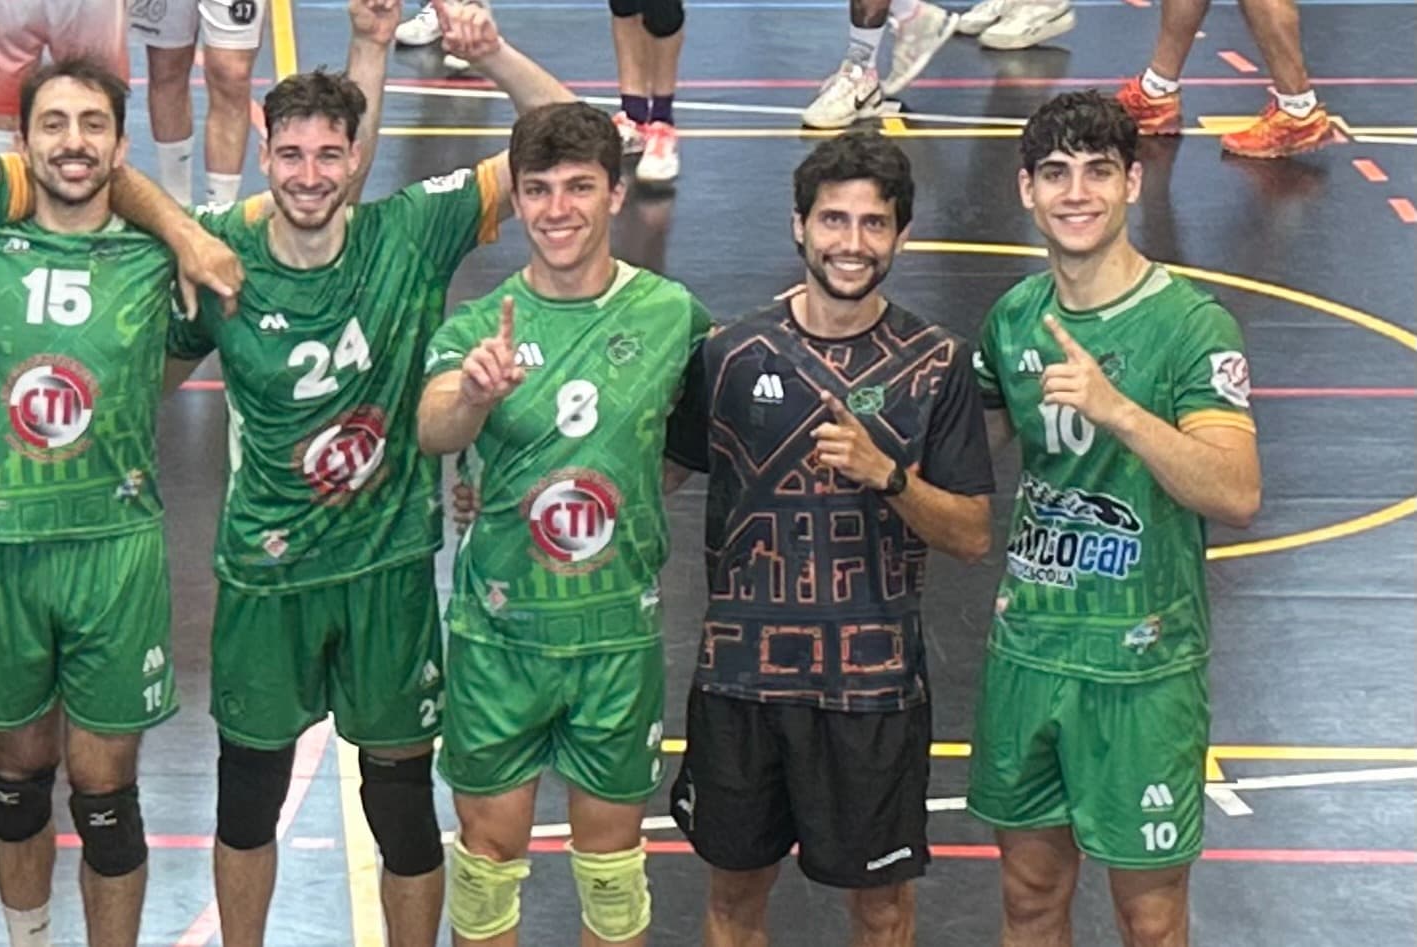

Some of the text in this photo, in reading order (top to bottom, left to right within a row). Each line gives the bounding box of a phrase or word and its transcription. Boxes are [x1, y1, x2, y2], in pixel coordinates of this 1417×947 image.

[22, 267, 92, 326] 15
[287, 316, 373, 400] 24
[22, 387, 73, 426] CTI
[556, 379, 599, 438] 8
[1038, 403, 1096, 457] 10
[315, 430, 372, 480] CTI
[542, 501, 597, 539] CTI
[1140, 821, 1179, 851] 10
